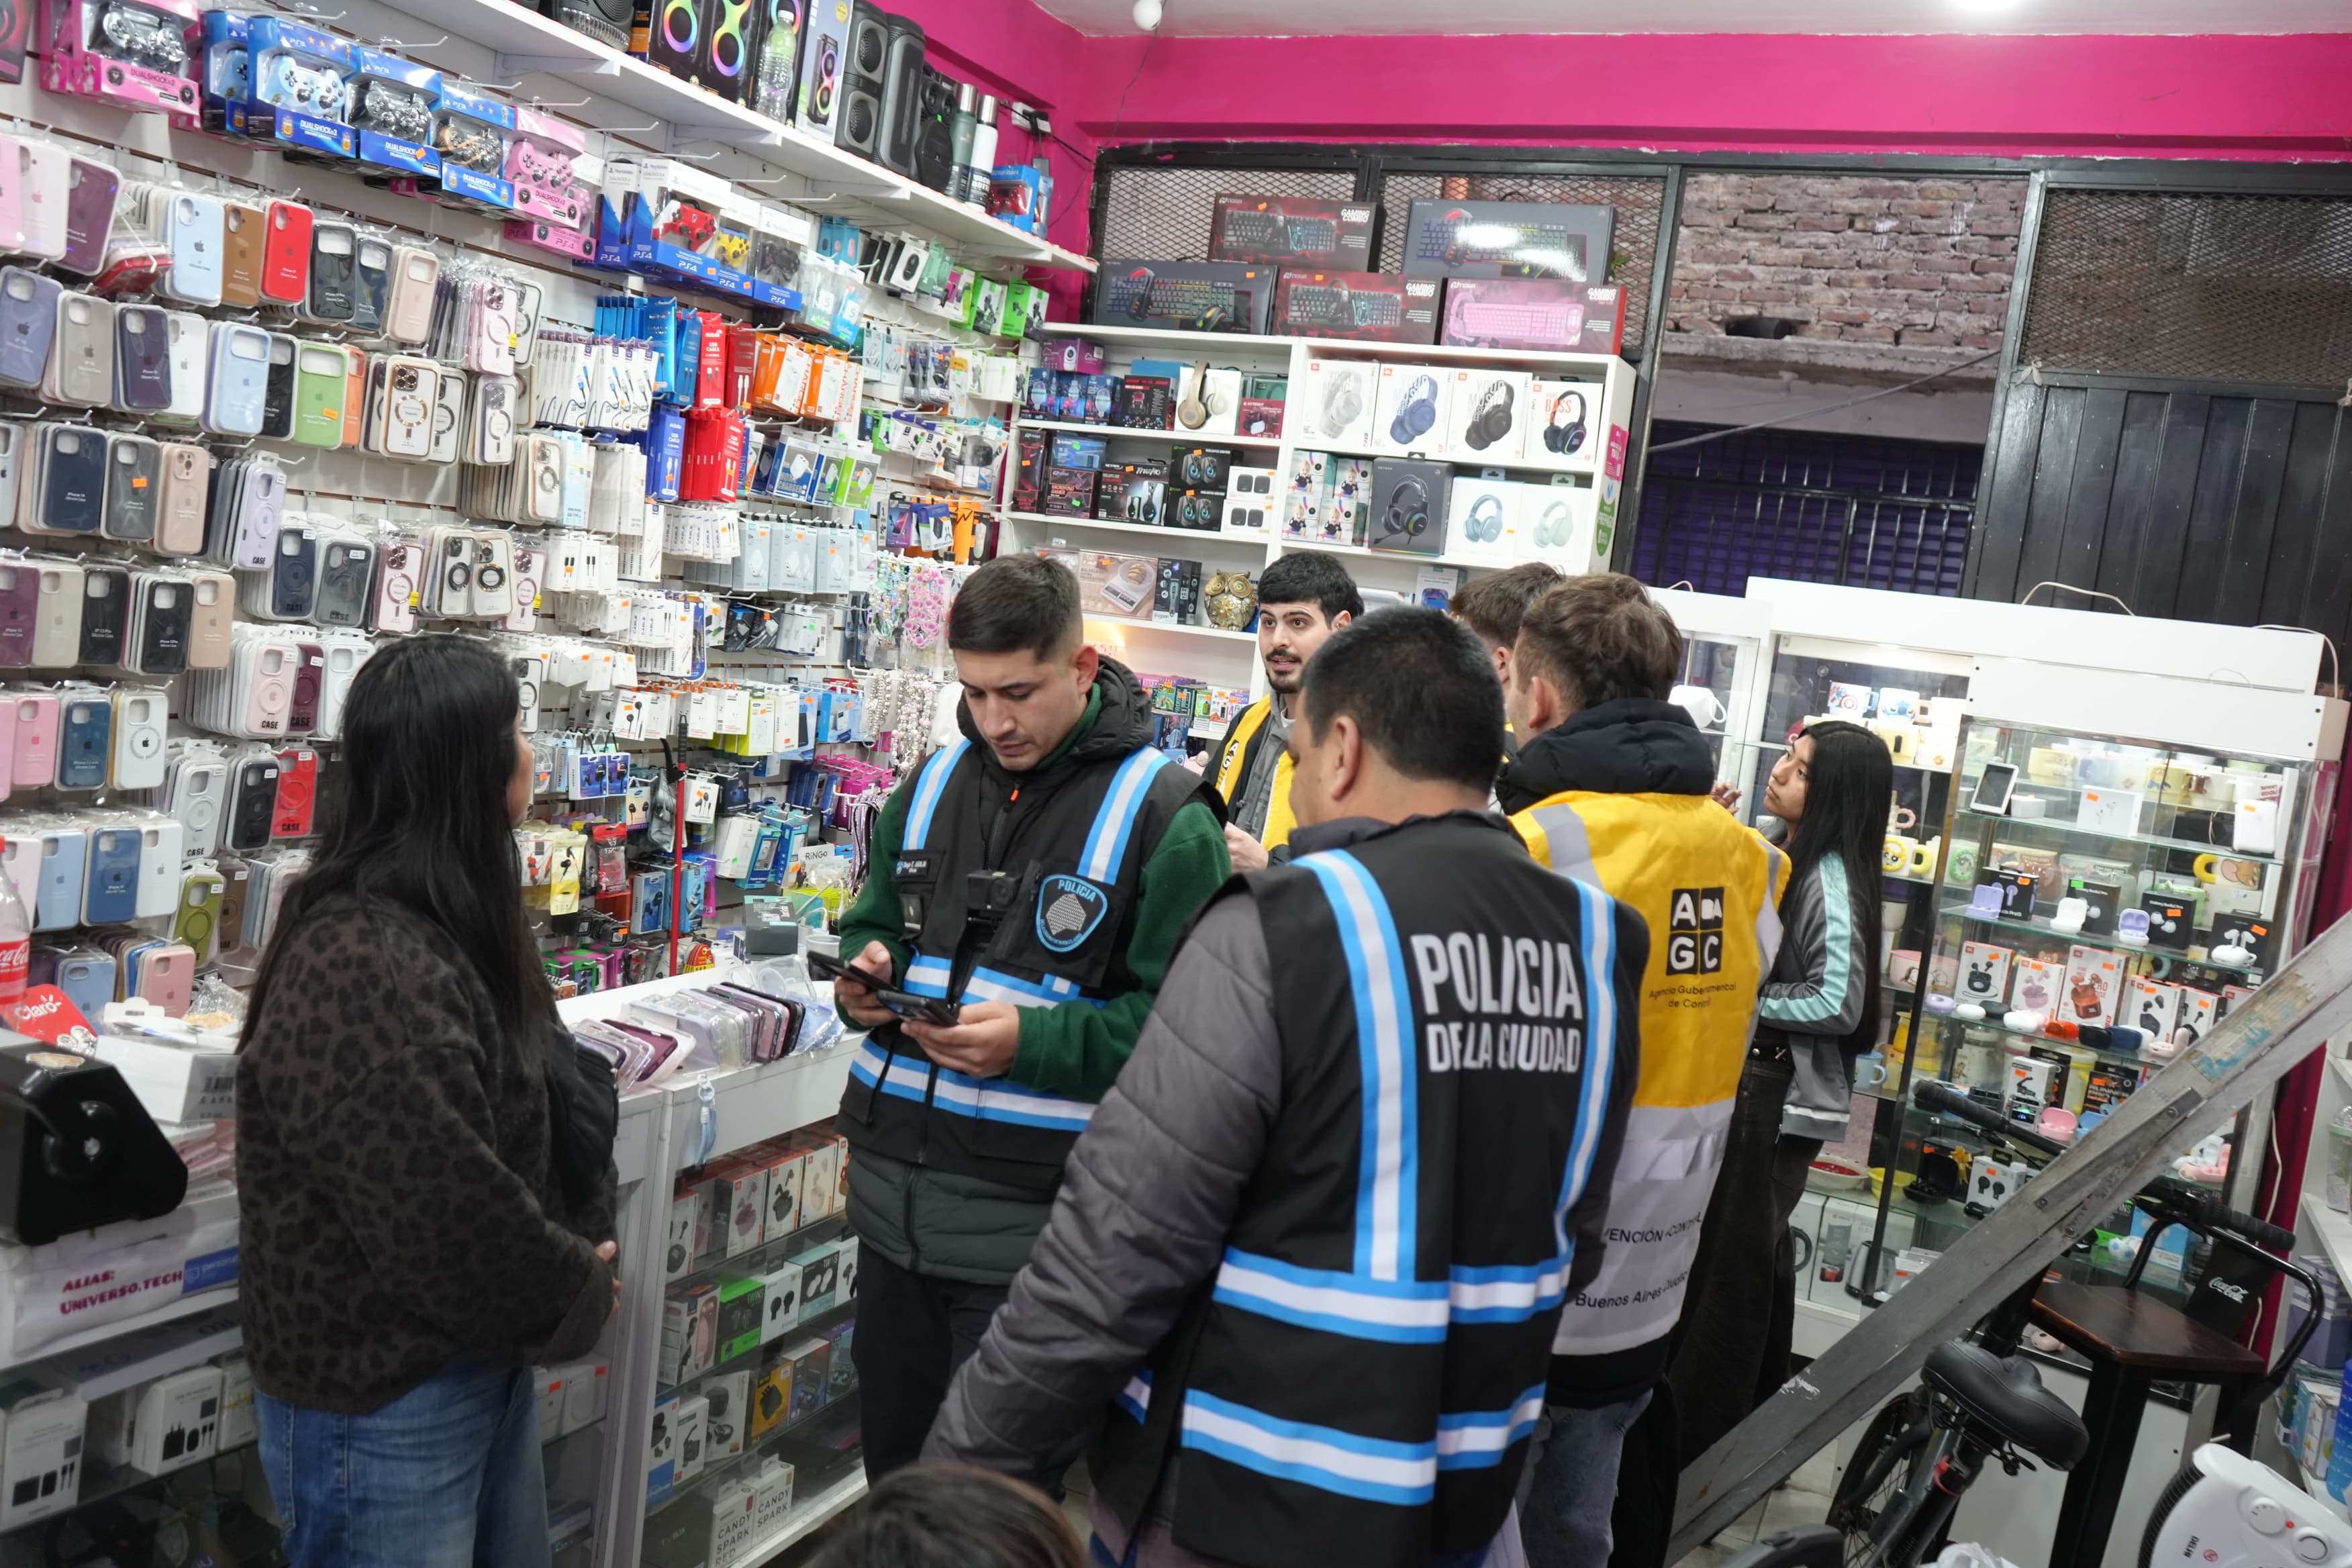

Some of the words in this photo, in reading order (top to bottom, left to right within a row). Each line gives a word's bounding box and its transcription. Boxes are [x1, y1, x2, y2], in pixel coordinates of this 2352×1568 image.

[289, 38, 307, 48] PS3
[374, 65, 390, 74] PS3
[1340, 209, 1370, 217] GAMING
[1342, 215, 1369, 223] COMBO
[600, 254, 622, 262] PS4
[633, 251, 653, 259] PS4
[679, 260, 698, 272] PS4
[719, 278, 736, 289] PS4
[1406, 283, 1436, 293] GAMING
[1408, 289, 1434, 297] COMBO
[1587, 288, 1617, 297] GAMING
[1589, 293, 1616, 301] COMBO
[771, 295, 786, 305] PS4
[1545, 398, 1571, 413] BASS
[252, 556, 266, 565] CASE
[330, 611, 349, 621] CASE
[261, 720, 279, 730] CASE
[290, 716, 310, 726] CASE
[281, 823, 301, 832] CASE
[187, 848, 205, 856] CASE
[1058, 879, 1097, 903] POLICIA
[1410, 932, 1583, 1020] POLICIA
[1649, 987, 1676, 1001] Agencia
[1668, 998, 1679, 1008] de
[15, 999, 58, 1020] Claro
[1426, 1021, 1464, 1073] DE
[1463, 1022, 1493, 1069] LA
[1498, 1023, 1581, 1073] CIUDAD
[62, 1269, 115, 1293] ALIAS:
[59, 1270, 183, 1316] UNIVERSO.TECH
[747, 1289, 765, 1304] TWINS
[1575, 1293, 1628, 1308] Buenos
[1632, 1287, 1661, 1304] Aires
[758, 1487, 790, 1513] CANDY
[757, 1502, 788, 1528] SPARK
[718, 1512, 752, 1539] CANDY
[716, 1526, 750, 1555] SPARK
[715, 1548, 736, 1568] RED
